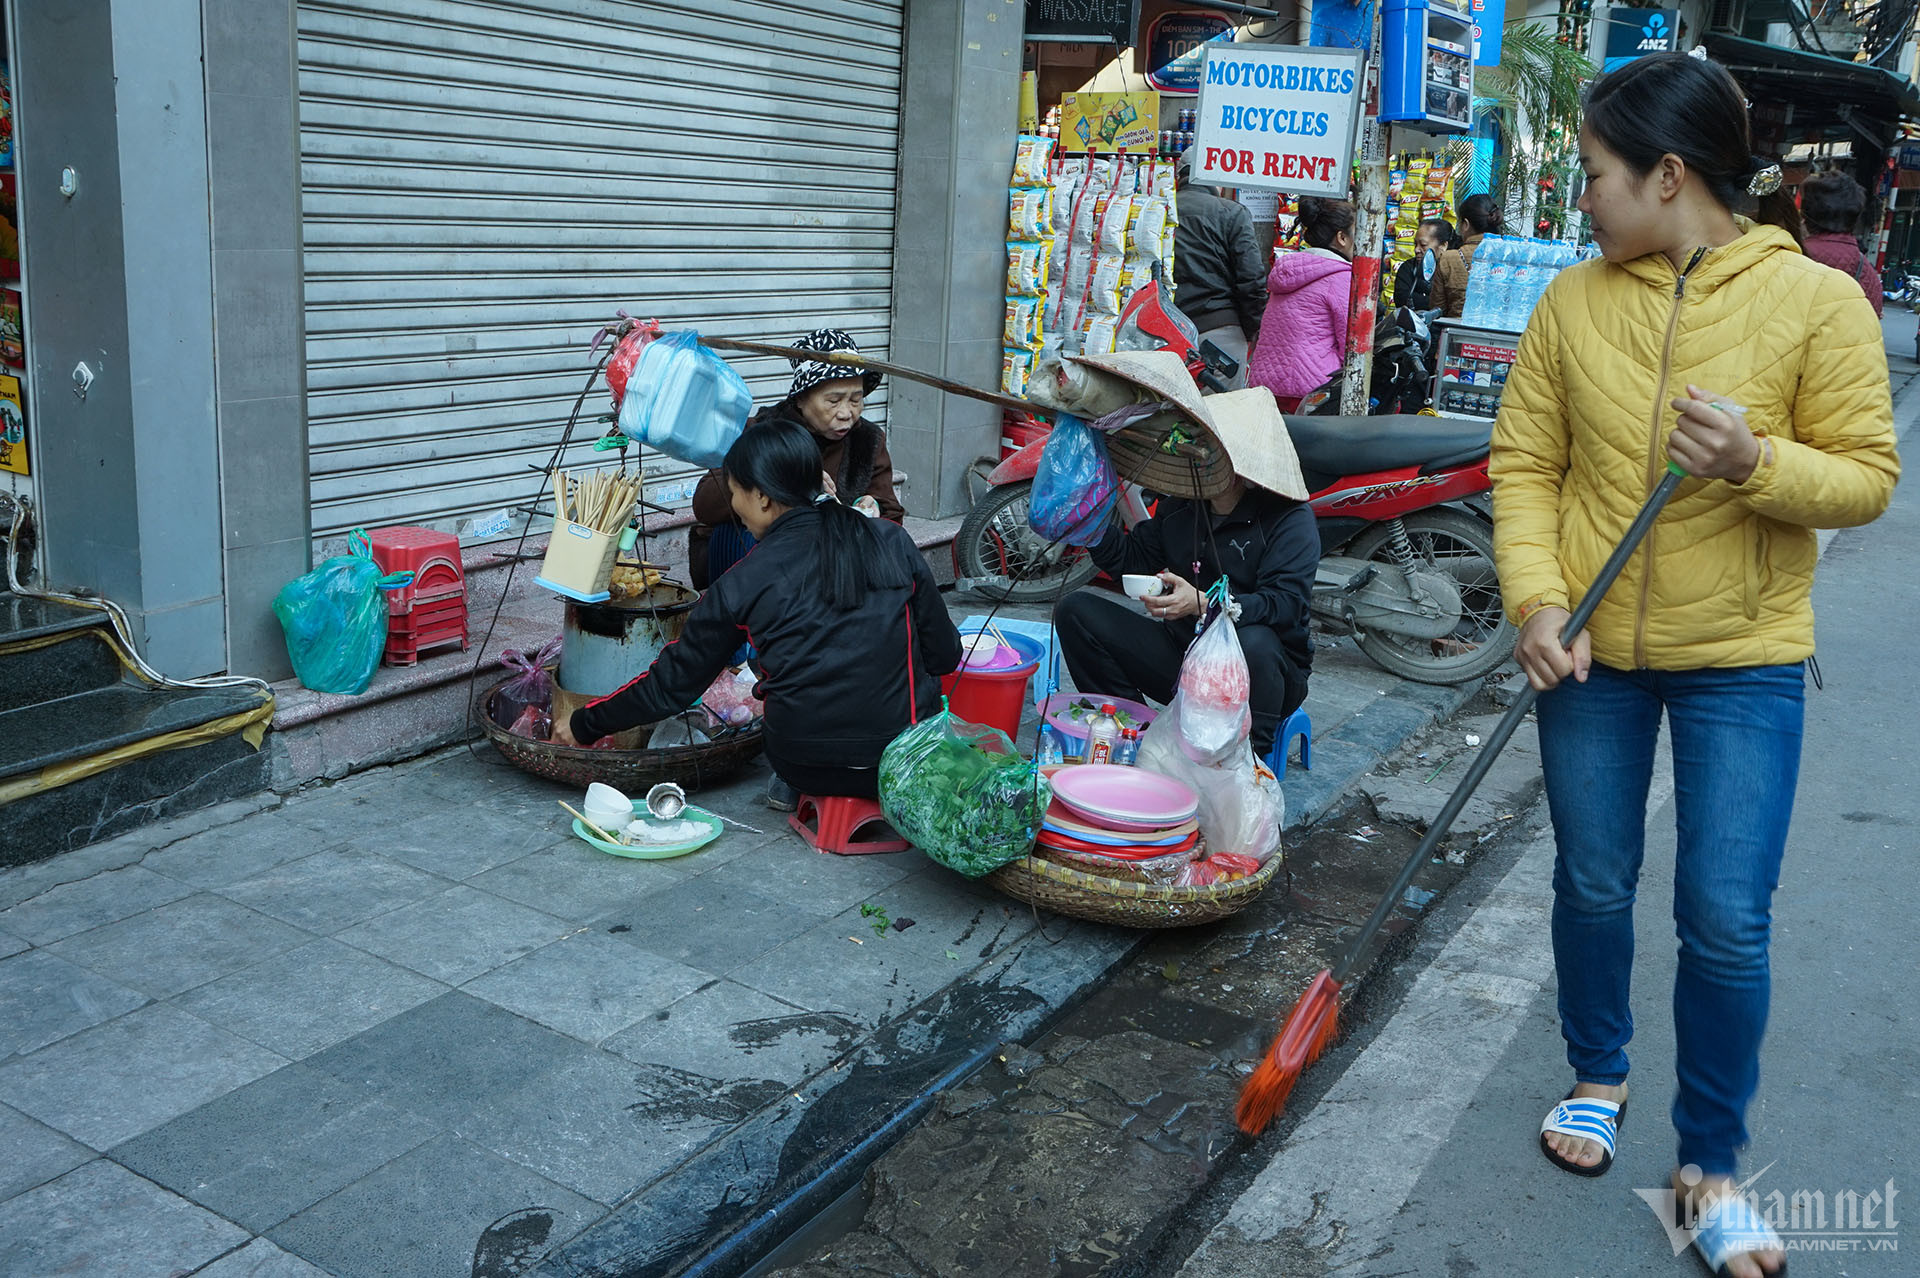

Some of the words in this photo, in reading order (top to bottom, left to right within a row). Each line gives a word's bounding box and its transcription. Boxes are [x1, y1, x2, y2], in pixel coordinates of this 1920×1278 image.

[1039, 0, 1127, 23] MASSAGE
[1636, 39, 1668, 50] ANZ
[1206, 60, 1355, 95] MOTORBIKES
[1220, 104, 1329, 137] BICYCLES
[1205, 148, 1255, 175] FOR
[1263, 153, 1336, 184] RENT
